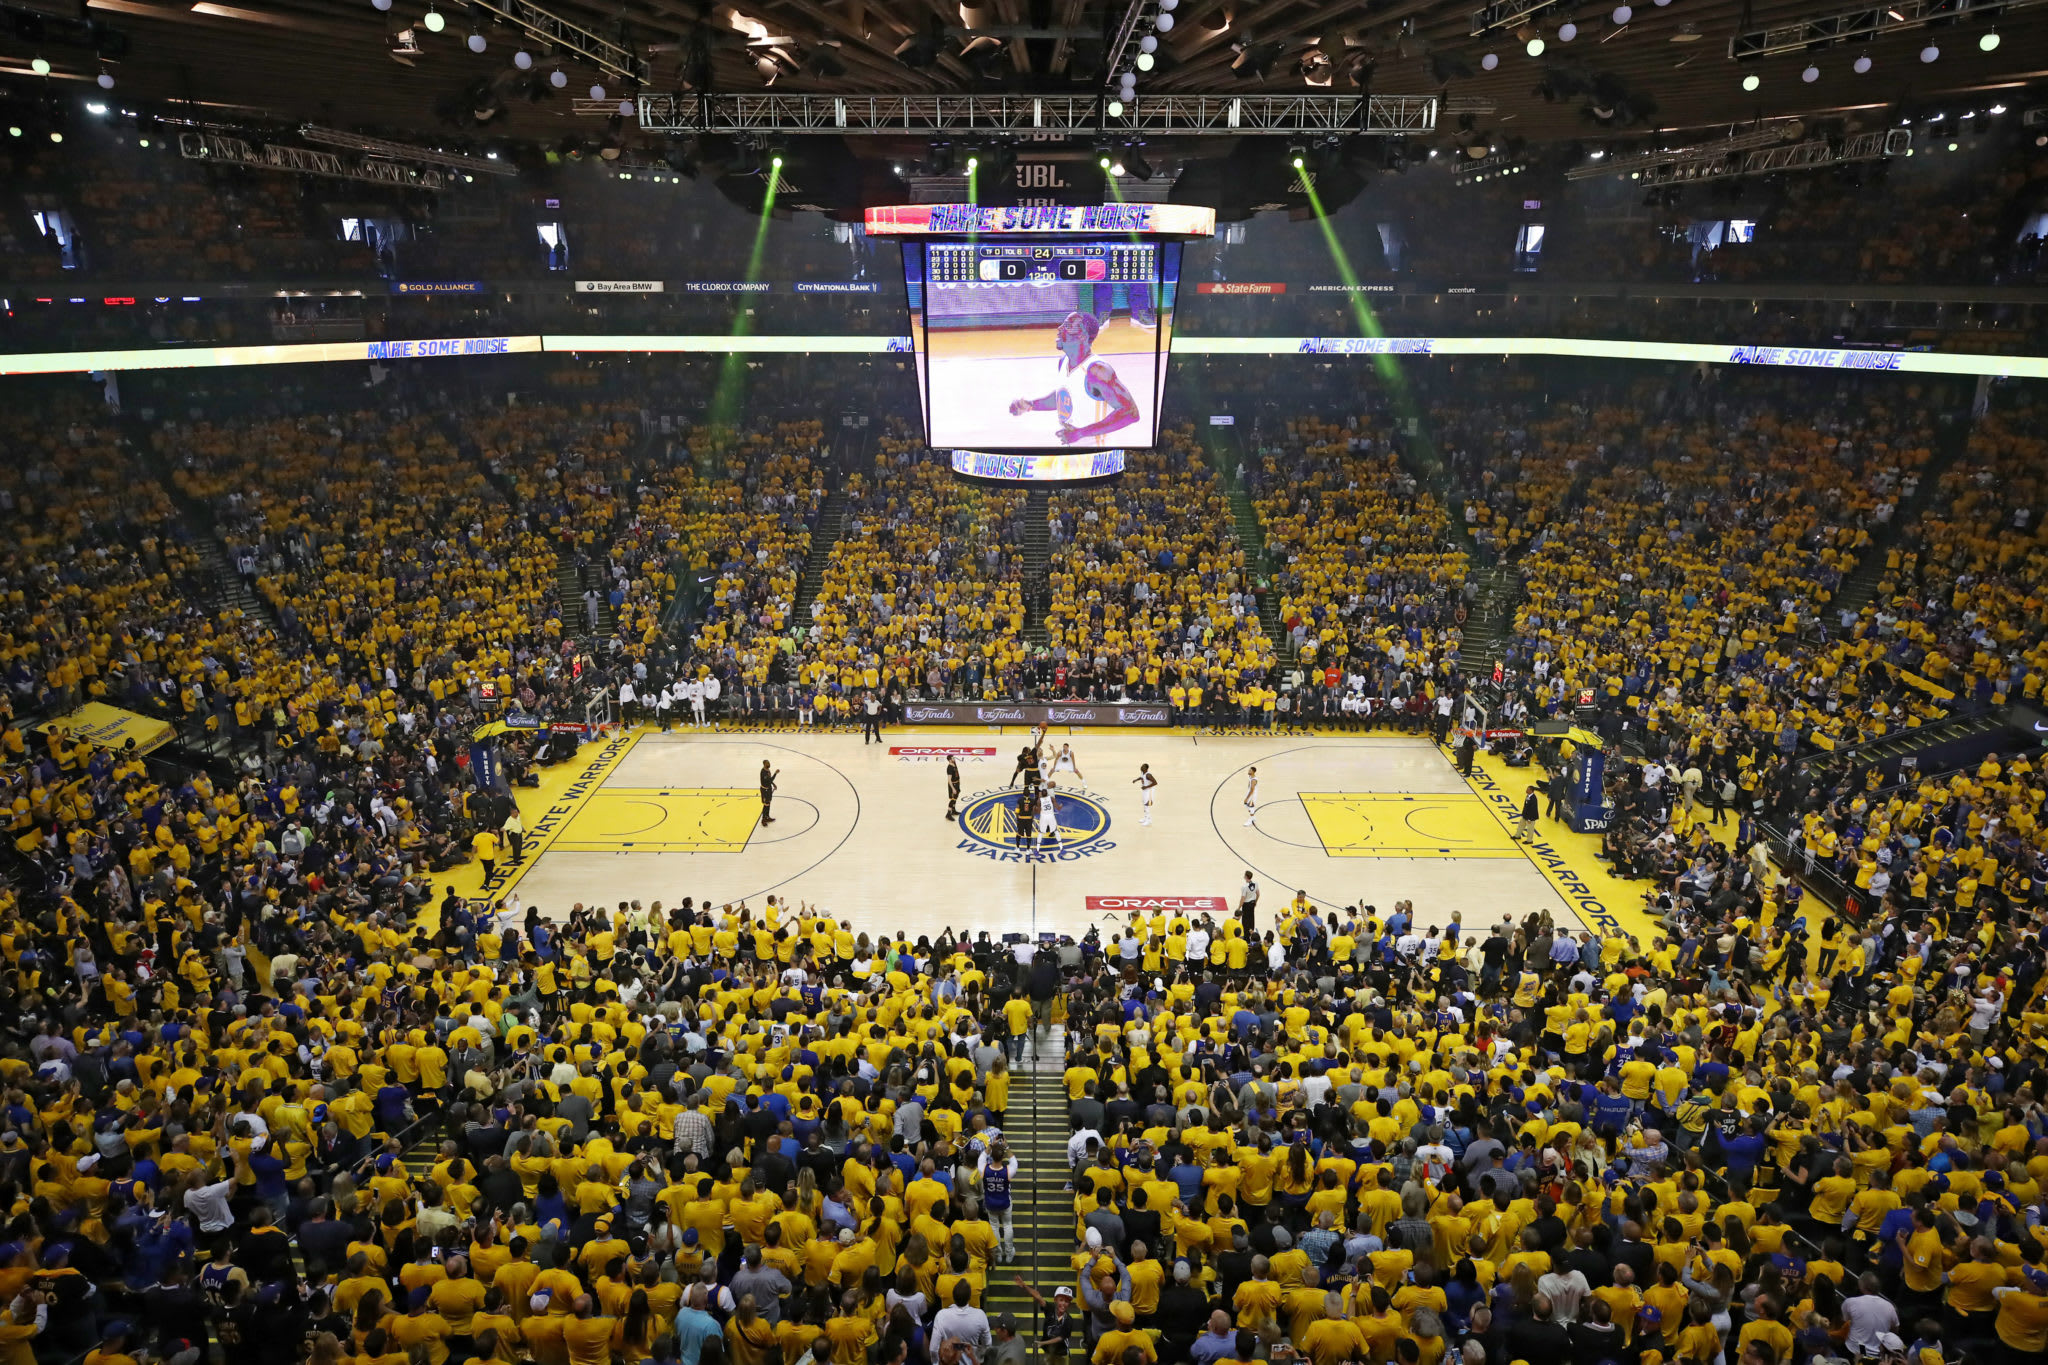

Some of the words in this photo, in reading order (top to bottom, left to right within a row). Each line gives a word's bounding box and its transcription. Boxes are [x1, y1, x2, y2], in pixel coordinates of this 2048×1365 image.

[1016, 165, 1064, 188] JBL
[929, 204, 992, 232] MAKE
[1002, 206, 1076, 230] SOME
[1080, 204, 1154, 230] NOISE
[1035, 249, 1050, 258] 24
[1007, 265, 1016, 275] 0
[1067, 265, 1076, 275] 0
[368, 341, 412, 359] MAKE
[418, 340, 460, 356] SOME
[464, 338, 509, 355] NOISE
[1299, 337, 1340, 354] MAKE
[1344, 340, 1383, 352] SOME
[1388, 340, 1435, 352] NOISE
[1730, 346, 1783, 364] MAKE
[1785, 350, 1839, 366] SOME
[1840, 352, 1905, 370] NOISE
[974, 455, 1037, 478] NOISE
[922, 708, 954, 719] Finals
[994, 708, 1025, 719] Finals
[1065, 709, 1096, 720] Finals
[1136, 709, 1167, 720] Finals
[86, 717, 132, 736] NATIONAL
[100, 729, 128, 741] BANK
[560, 737, 630, 802] WARRIORS
[961, 785, 1029, 802] GOLDE
[1058, 786, 1109, 802] STATE
[1584, 784, 1589, 793] TV
[522, 806, 572, 850] STATE
[956, 839, 1117, 863] WARRIORS
[467, 855, 528, 912] OLDEN
[1532, 842, 1629, 939] WARRIOR
[1100, 899, 1213, 908] ORACLE
[1721, 1125, 1736, 1134] 30
[987, 1183, 1004, 1192] 35
